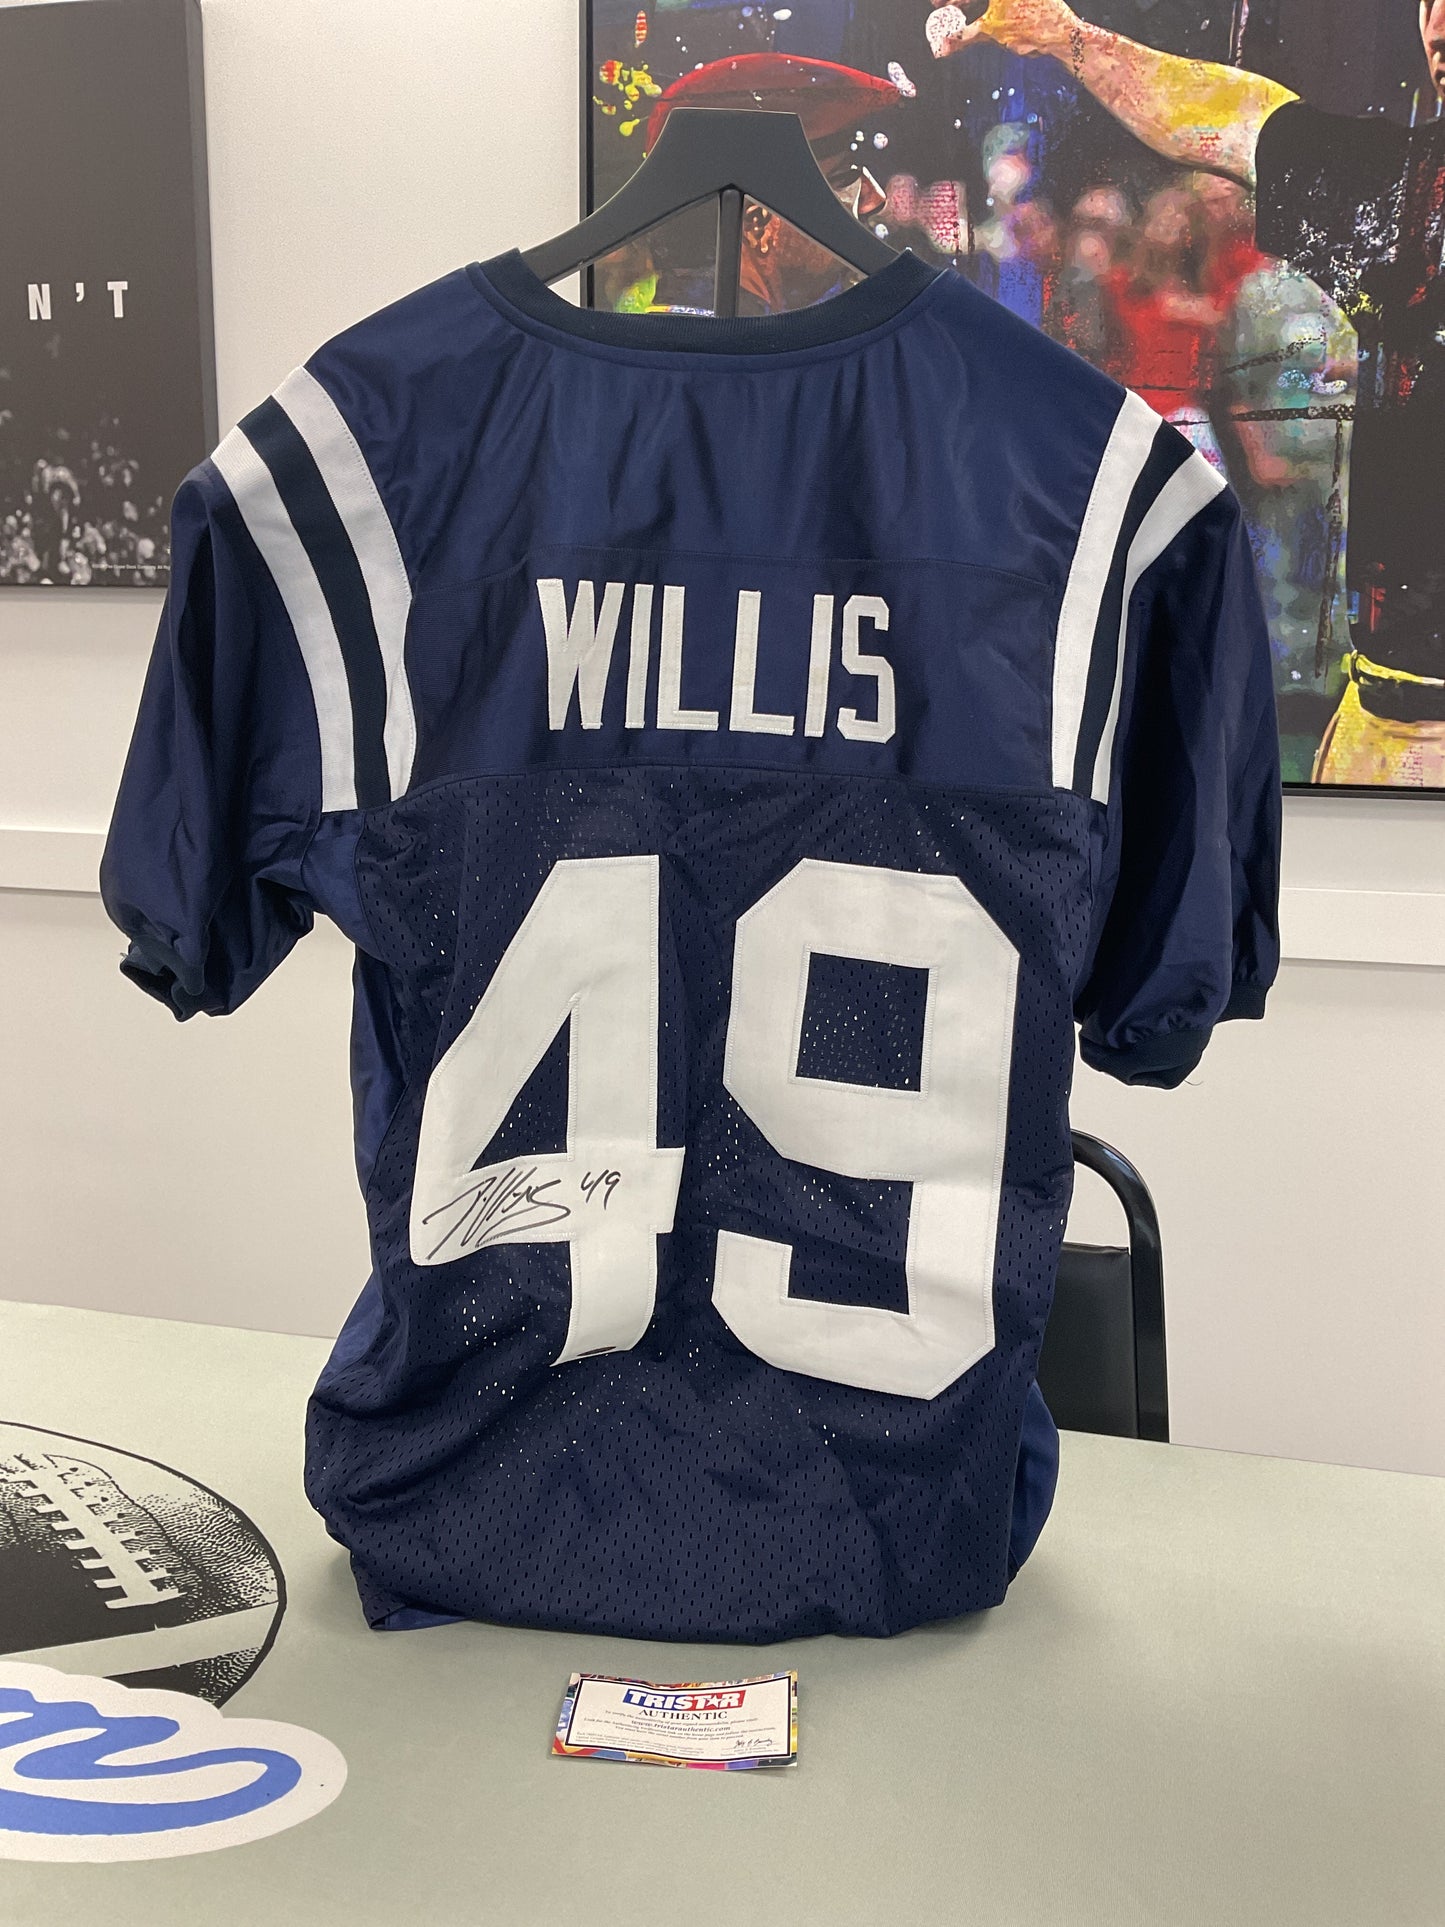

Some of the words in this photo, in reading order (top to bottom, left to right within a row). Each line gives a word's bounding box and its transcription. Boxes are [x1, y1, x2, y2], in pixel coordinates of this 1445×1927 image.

[536, 578, 896, 744] WILLIS
[410, 855, 1020, 1400] 49
[580, 1169, 622, 1210] 49
[638, 1709, 728, 1720] AUTHENTIC
